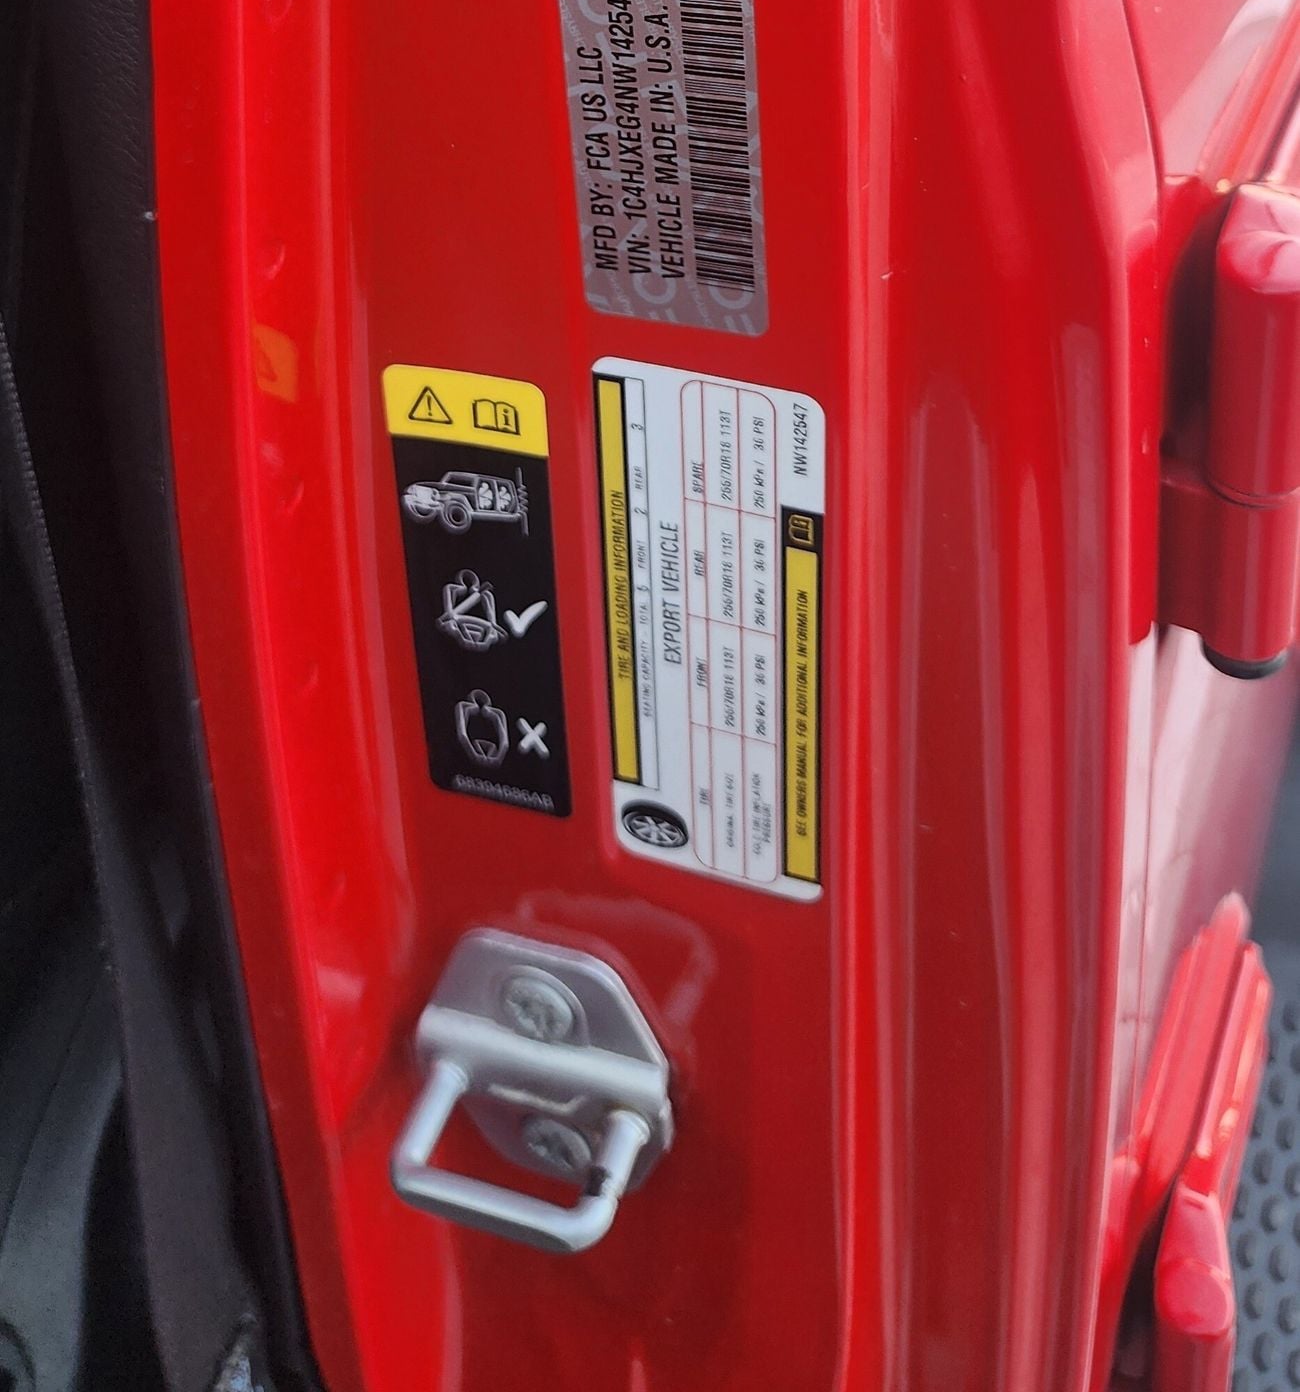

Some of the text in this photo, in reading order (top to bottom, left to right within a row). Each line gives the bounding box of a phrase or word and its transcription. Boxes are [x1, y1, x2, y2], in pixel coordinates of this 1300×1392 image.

[576, 46, 619, 271] MFD BY: FCA US LLC
[644, 5, 686, 279] VEHICLE MADE IN: U.S.A.
[623, 233, 652, 275] VIN:
[631, 423, 643, 431] 3
[793, 403, 808, 477] NW142547
[611, 490, 626, 572] INFORMATION
[634, 508, 646, 516] 2
[660, 521, 683, 665] EXPORT VEHICLE
